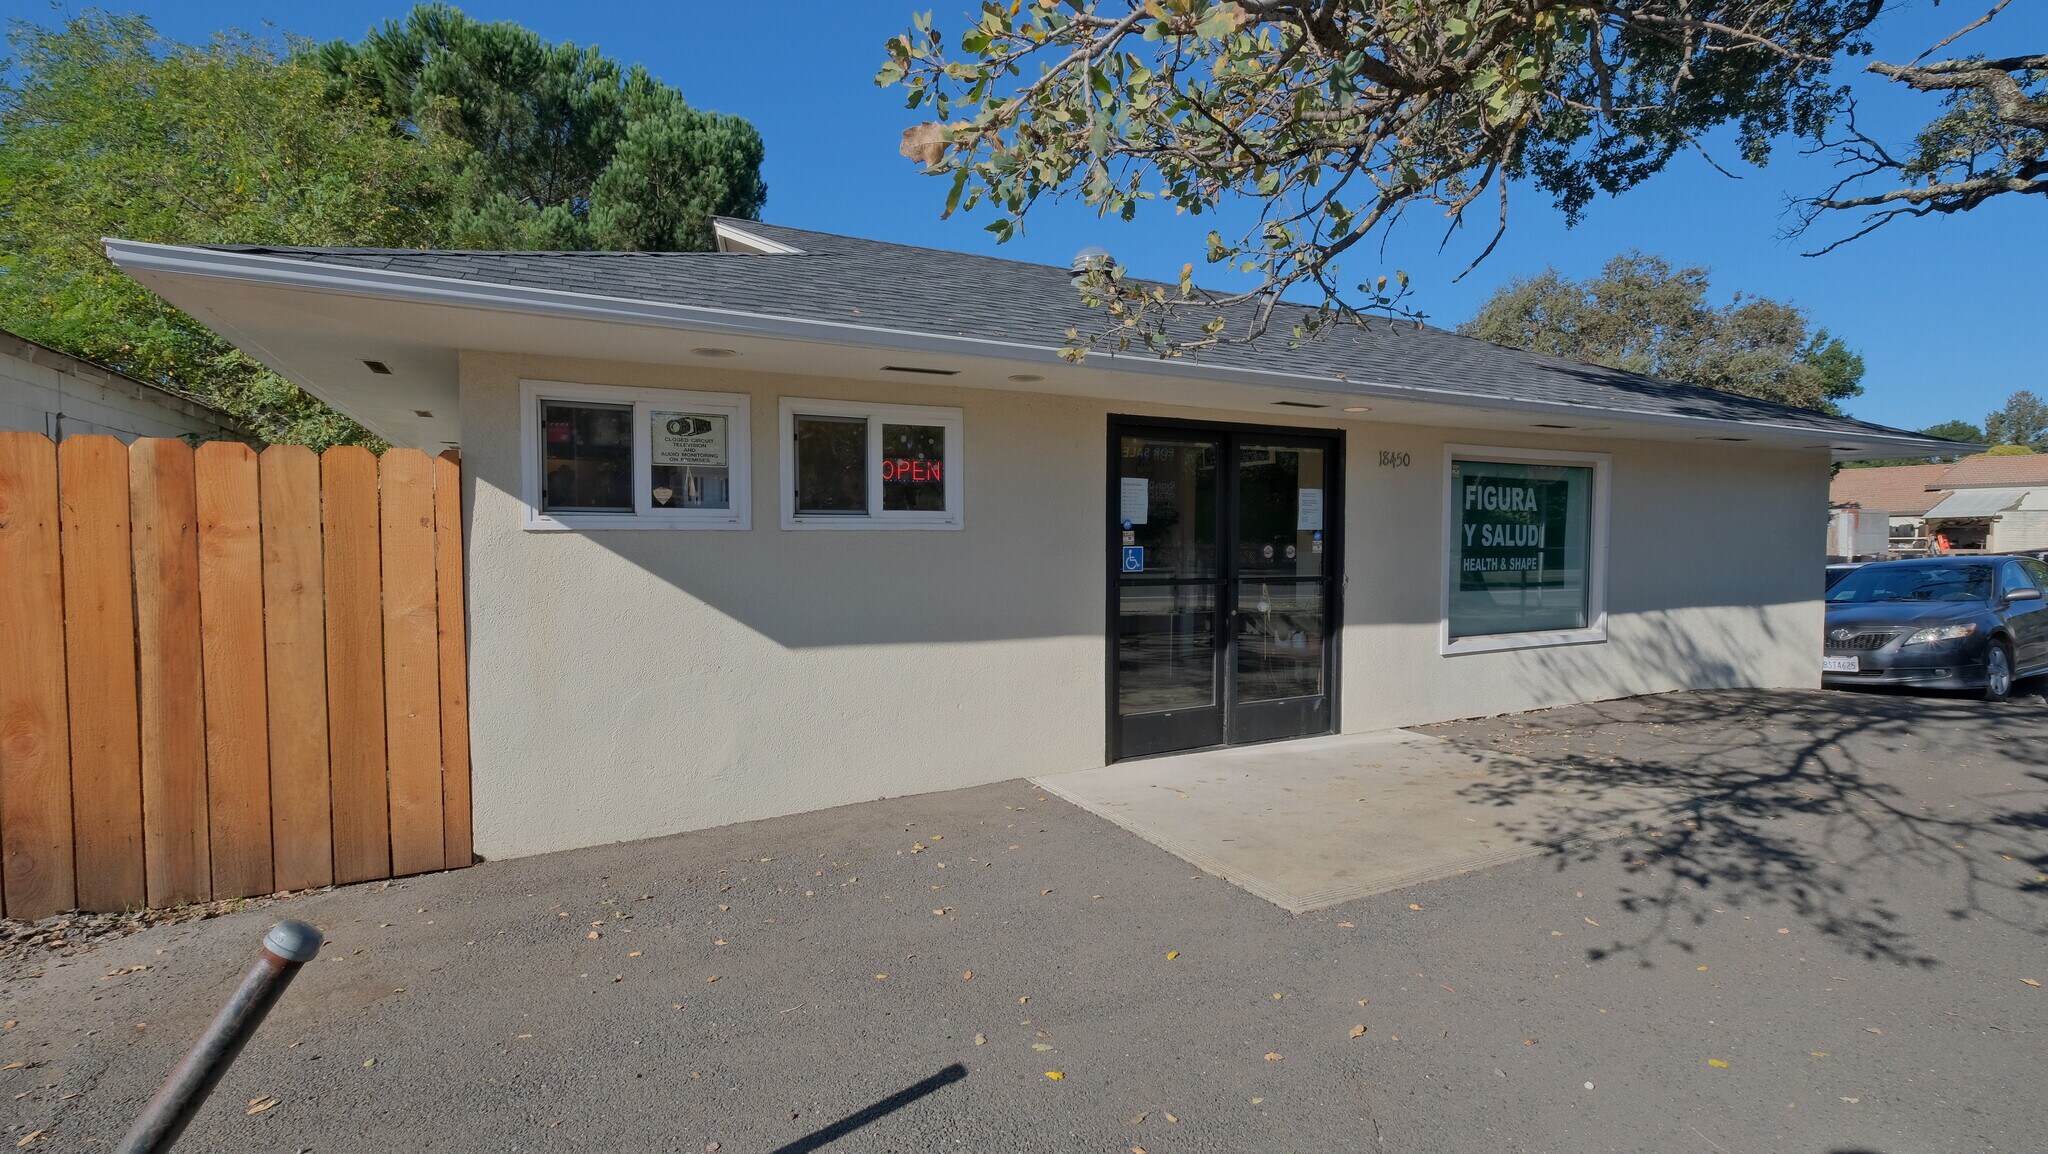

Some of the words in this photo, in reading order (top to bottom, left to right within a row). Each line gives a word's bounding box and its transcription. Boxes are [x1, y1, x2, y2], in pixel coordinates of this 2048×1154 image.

[1379, 450, 1410, 469] 18450
[882, 460, 941, 481] OPEN
[1465, 485, 1538, 511] FIGURA
[1464, 523, 1476, 547] Y
[1481, 523, 1538, 547] SALUD
[1463, 557, 1498, 571] HEALTH
[1500, 558, 1507, 570] &
[1509, 557, 1537, 570] SHAPE
